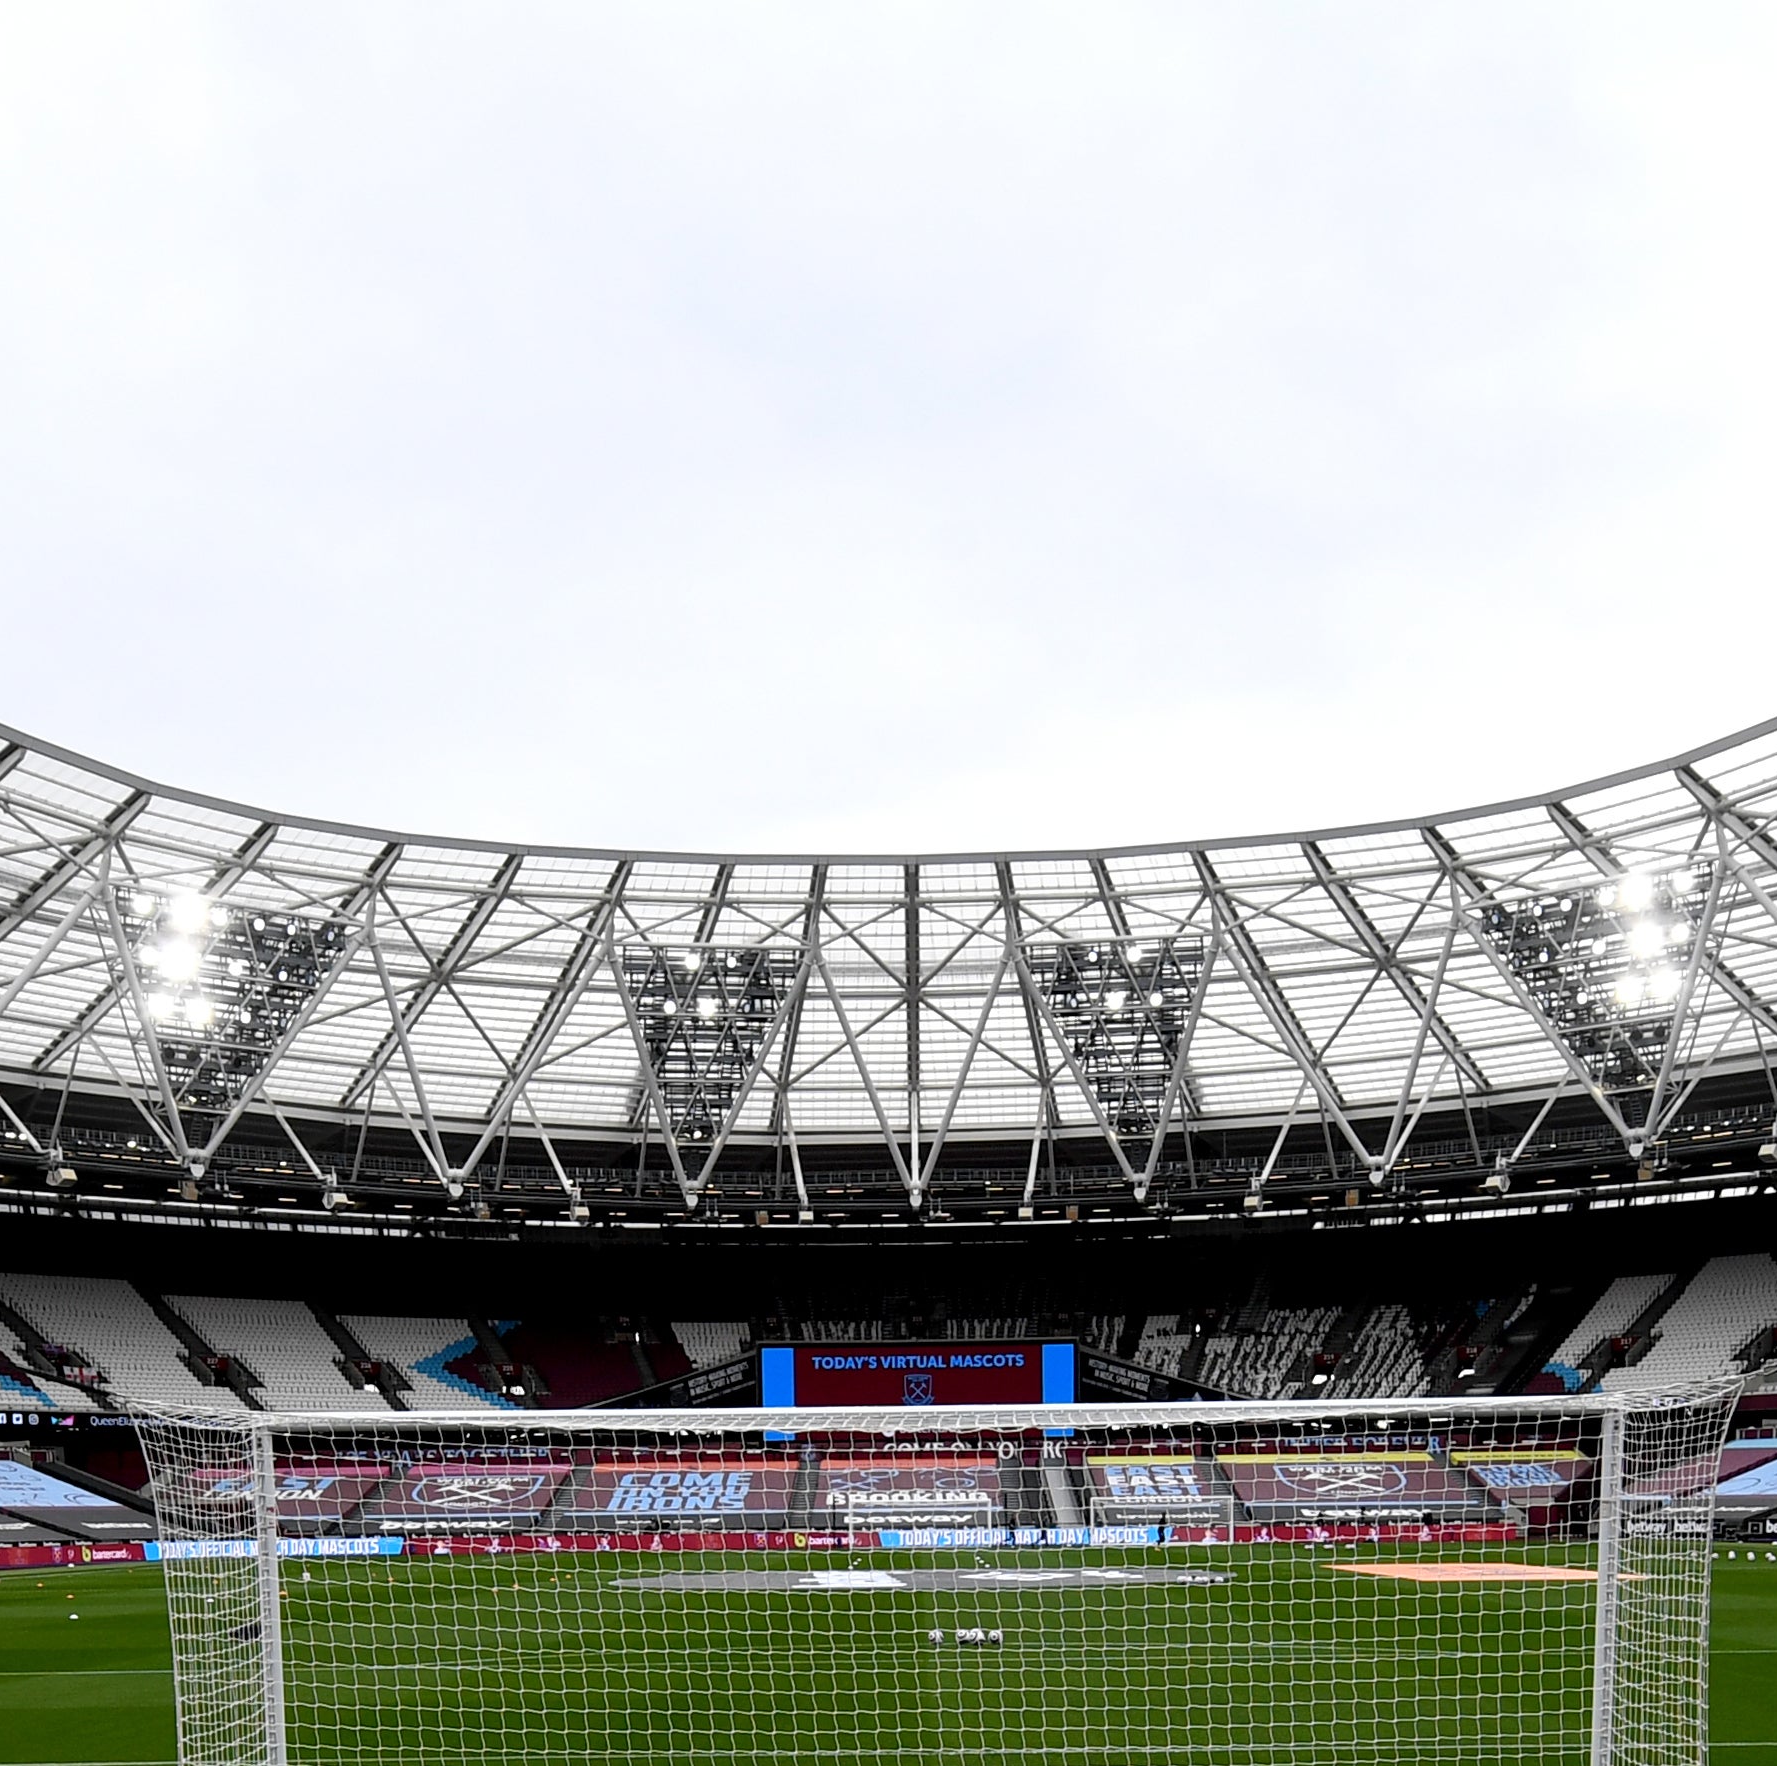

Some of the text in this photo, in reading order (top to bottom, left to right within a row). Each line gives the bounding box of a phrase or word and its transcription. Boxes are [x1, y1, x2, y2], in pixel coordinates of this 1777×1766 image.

[812, 1354, 1024, 1369] TODAY'S VIRTUAL MASCOTS
[1106, 1465, 1193, 1476] EAST
[620, 1472, 754, 1487] COME
[1107, 1475, 1198, 1486] EAST
[204, 1488, 324, 1501] LONON
[614, 1486, 750, 1499] ON YOU
[1111, 1485, 1202, 1496] EAST
[606, 1496, 745, 1511] IRONS
[826, 1491, 989, 1505] BROOKING
[843, 1513, 973, 1524] betway
[1626, 1520, 1666, 1534] betway
[899, 1529, 951, 1546] TODAY'S
[954, 1529, 1008, 1546] OFFICIAL
[1060, 1528, 1084, 1545] DAY
[1091, 1527, 1149, 1545] MASCOTS
[293, 1539, 315, 1556] DAY
[320, 1538, 379, 1556] MASCOTS
